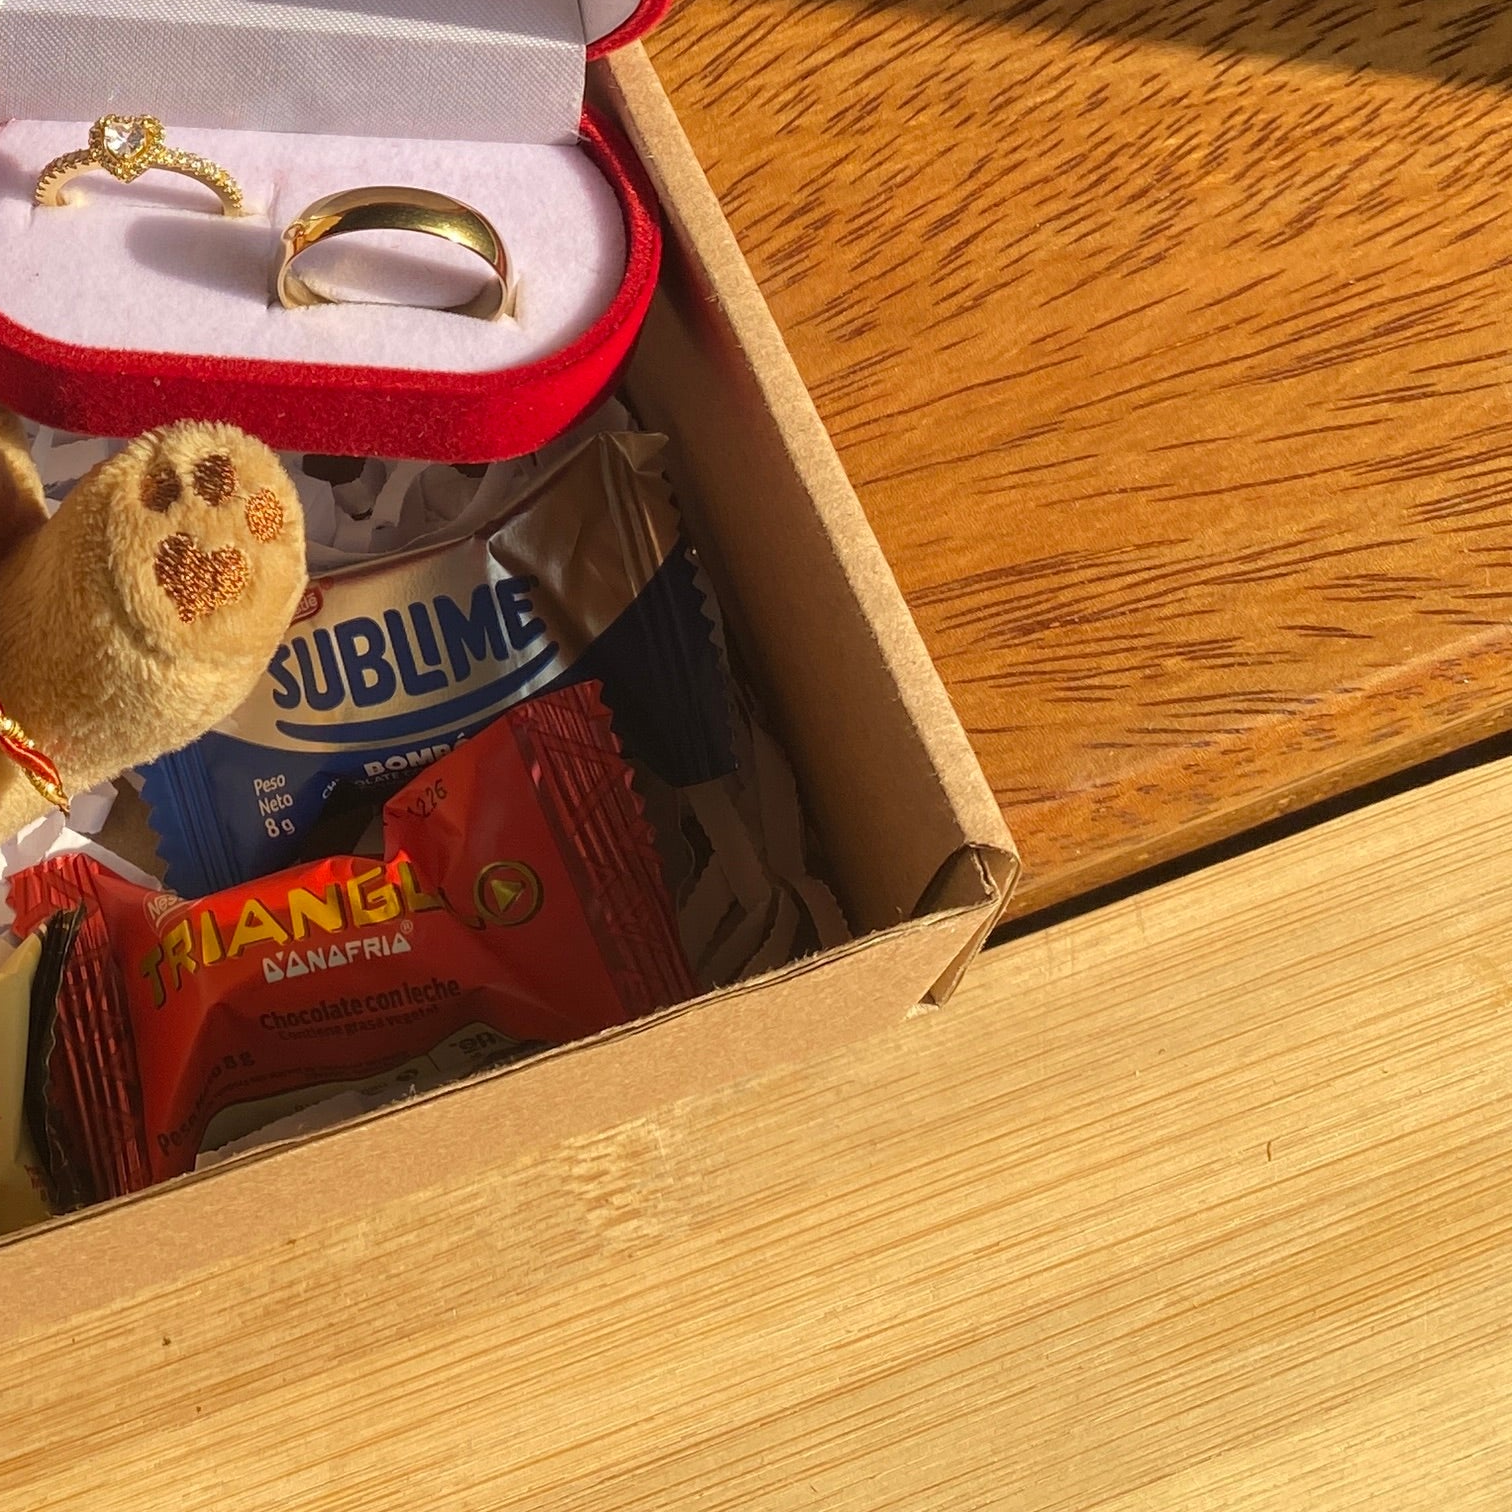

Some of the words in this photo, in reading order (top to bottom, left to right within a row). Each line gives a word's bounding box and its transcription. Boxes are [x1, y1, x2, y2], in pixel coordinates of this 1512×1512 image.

[267, 575, 547, 711] SUBLIME
[363, 732, 468, 777] BOMB
[253, 774, 286, 796] Peso
[258, 793, 293, 817] Neto
[265, 818, 280, 838] 8
[281, 818, 295, 835] g
[259, 998, 362, 1031] Chocolate
[365, 987, 404, 1012] con
[402, 977, 462, 1005] leche
